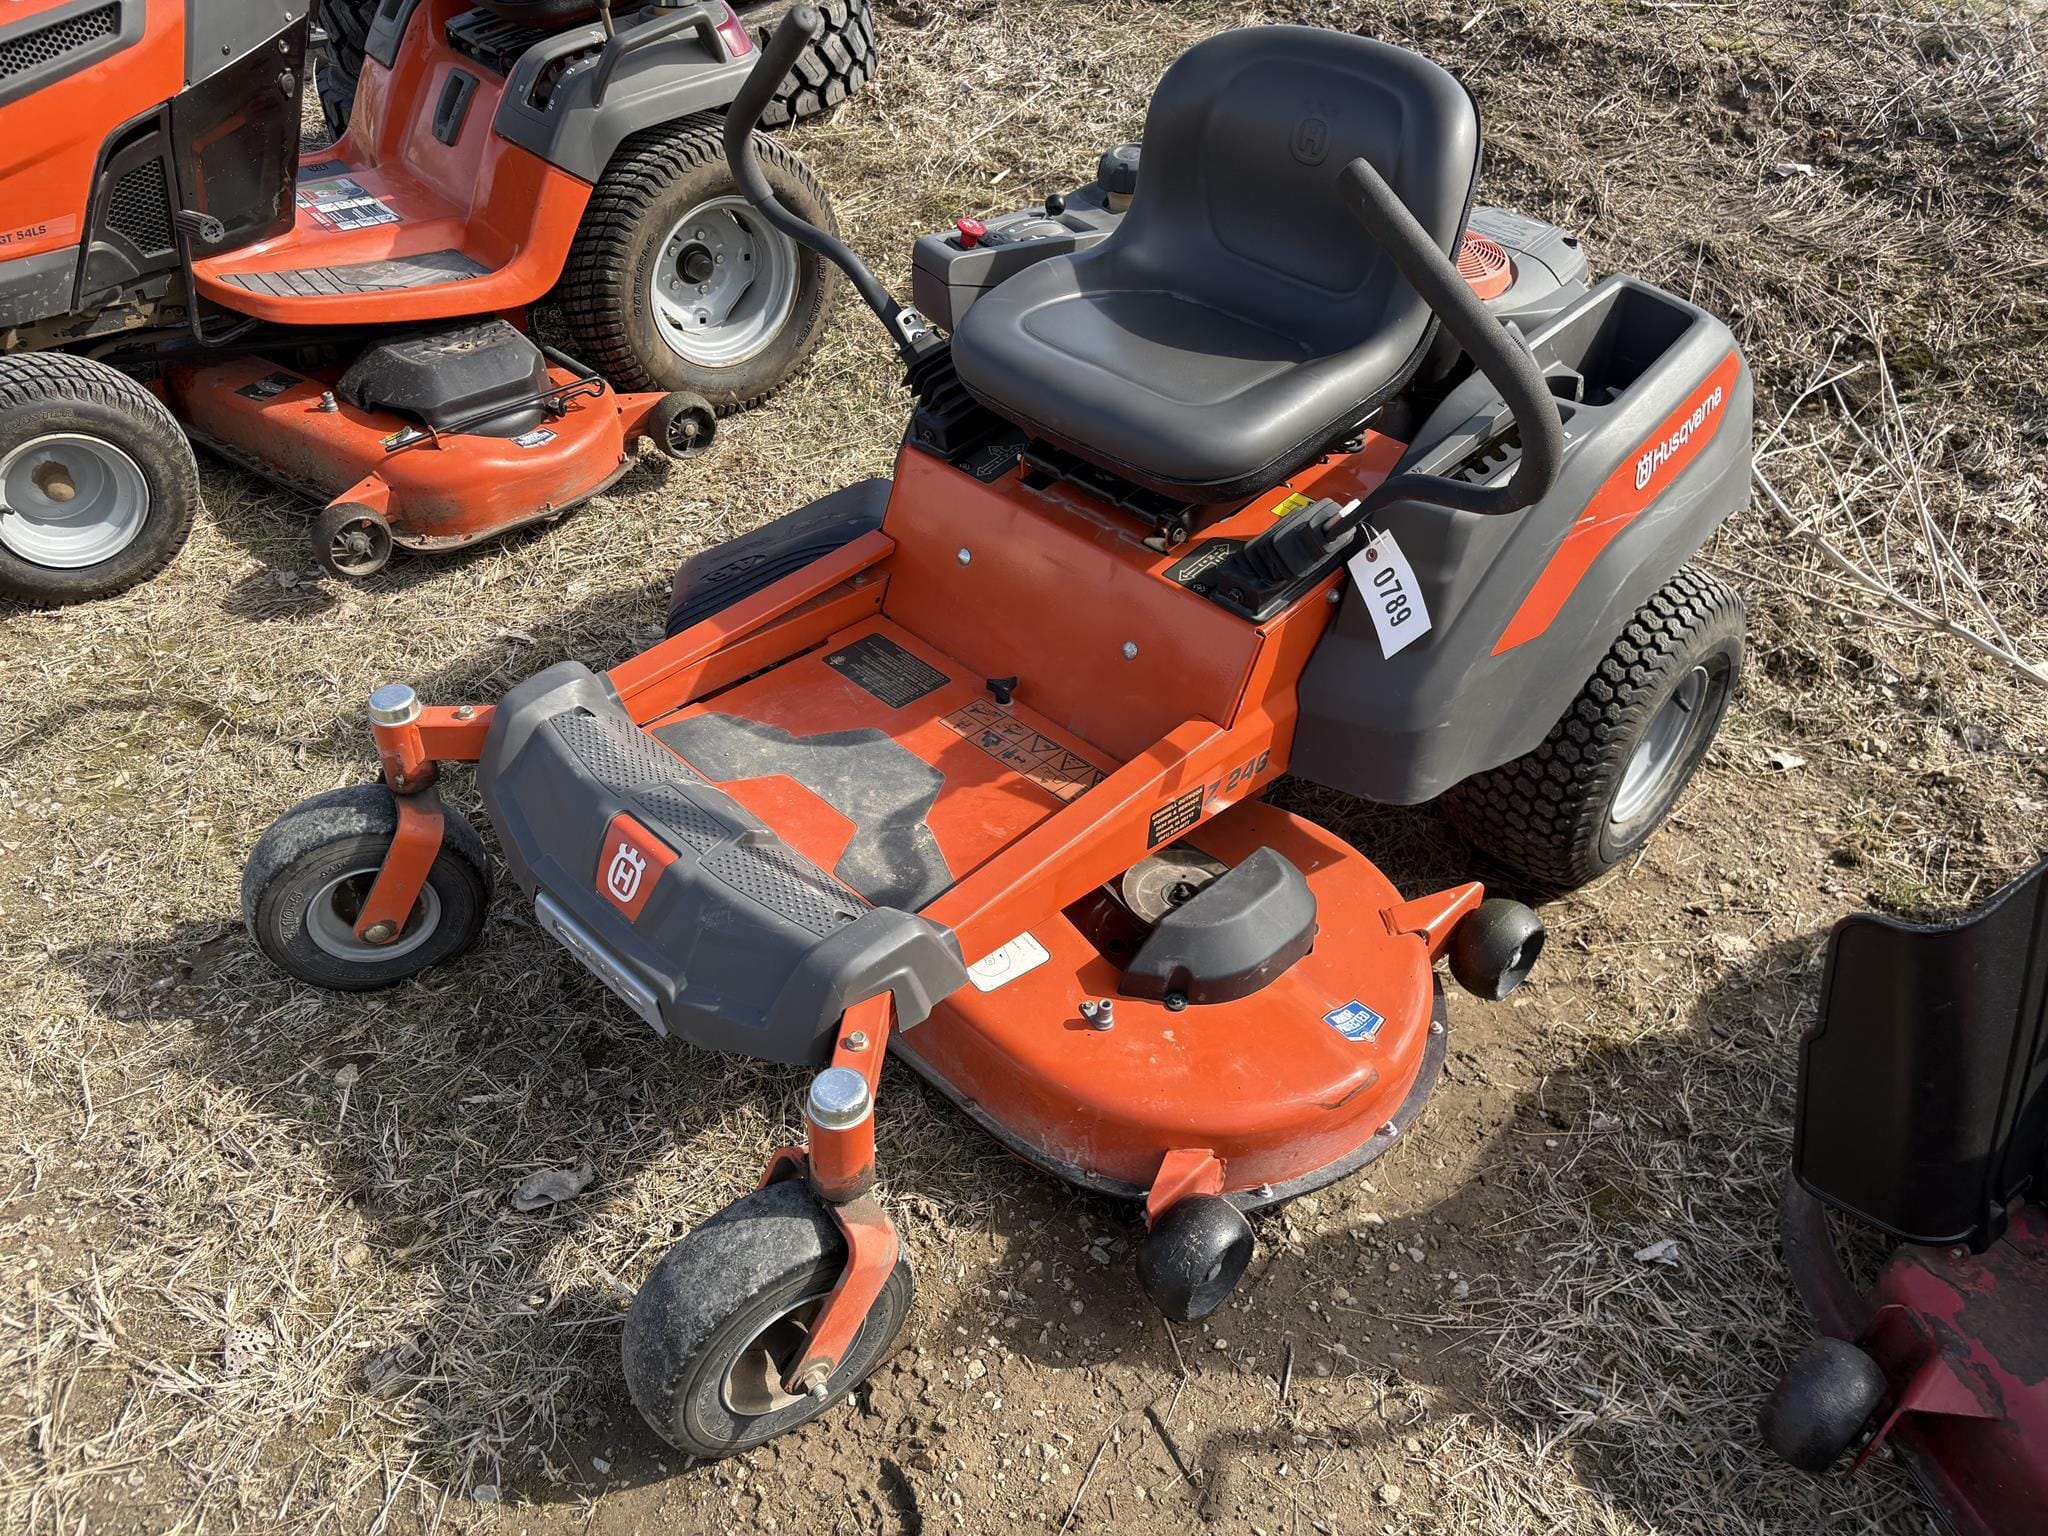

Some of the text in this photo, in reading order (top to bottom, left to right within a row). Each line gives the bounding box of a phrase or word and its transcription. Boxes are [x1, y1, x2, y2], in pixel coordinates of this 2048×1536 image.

[16, 225, 47, 240] 54LS
[634, 232, 656, 318] CARLISLE
[1653, 386, 1722, 473] Husqvarna
[1373, 567, 1412, 627] 0789
[1204, 748, 1271, 806] Z 246
